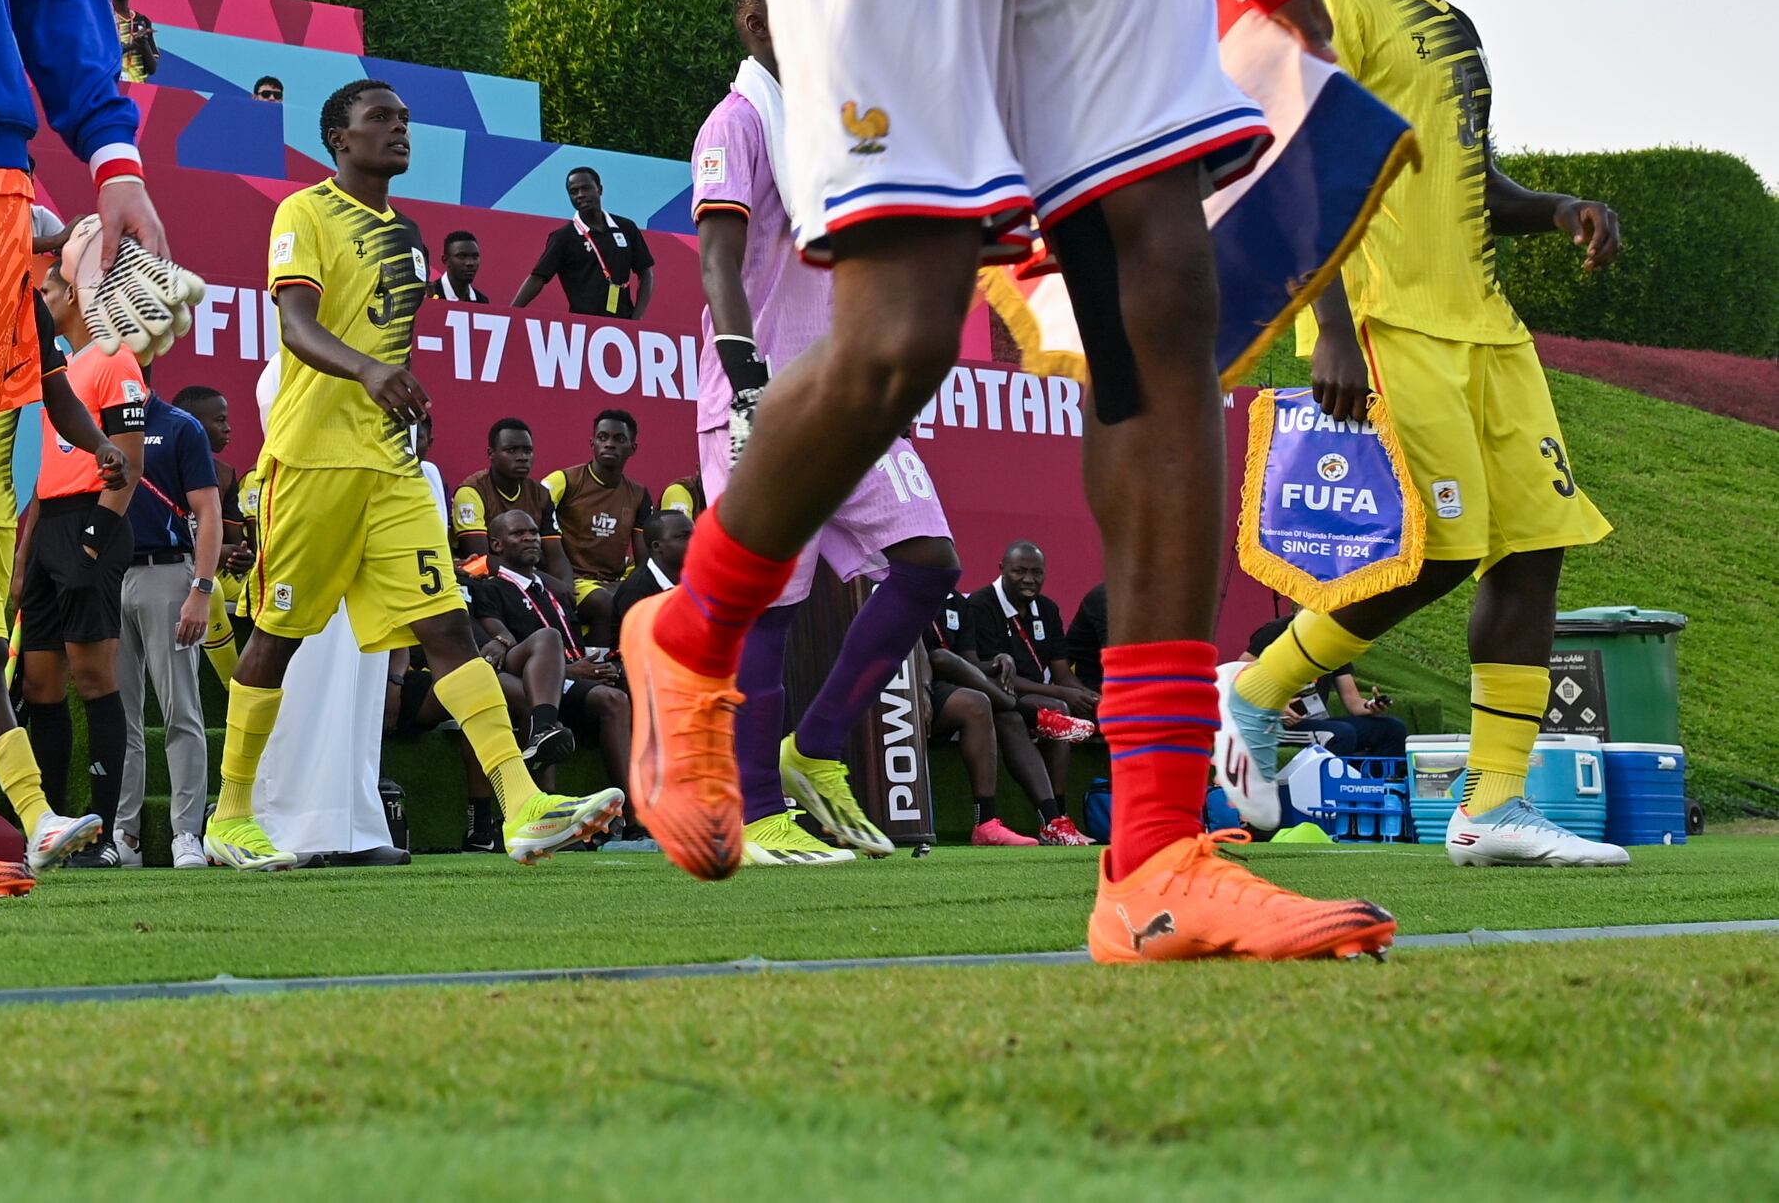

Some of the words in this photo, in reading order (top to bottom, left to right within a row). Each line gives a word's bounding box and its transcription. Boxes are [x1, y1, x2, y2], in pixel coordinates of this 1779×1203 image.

[417, 309, 511, 383] -17
[144, 436, 162, 445] IFA
[875, 450, 933, 503] 18
[1539, 436, 1576, 499] 3
[1281, 483, 1379, 515] FUFA
[1282, 540, 1331, 556] SINCE
[1336, 544, 1370, 559] 1924
[1303, 531, 1327, 540] Uganda
[416, 549, 443, 597] 5
